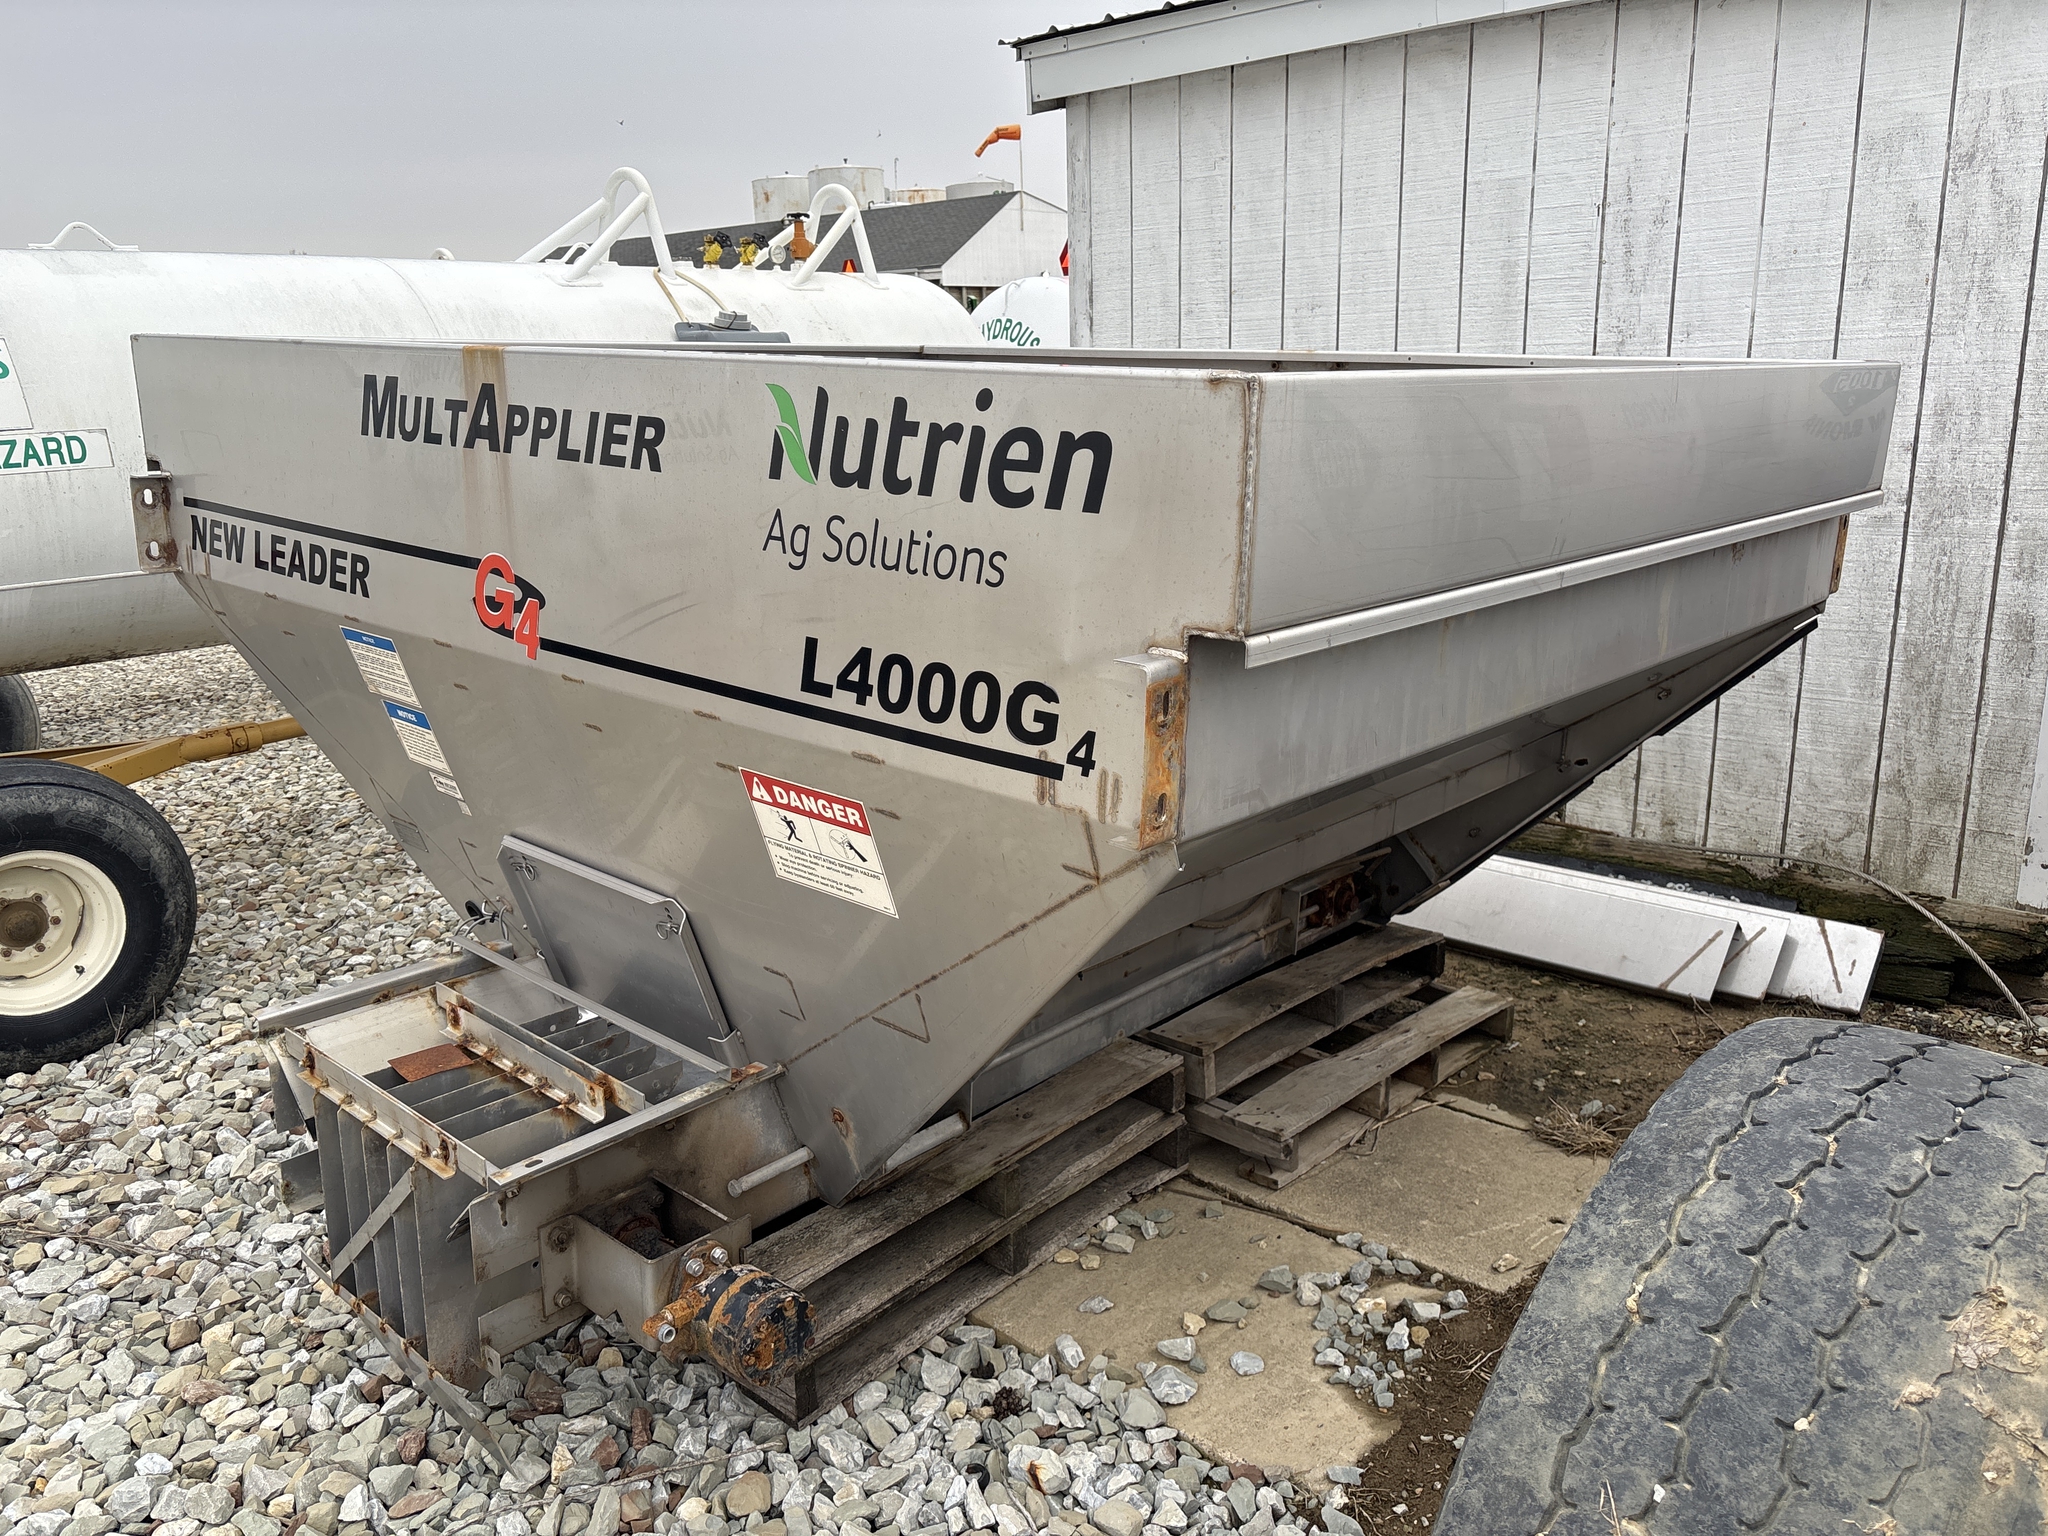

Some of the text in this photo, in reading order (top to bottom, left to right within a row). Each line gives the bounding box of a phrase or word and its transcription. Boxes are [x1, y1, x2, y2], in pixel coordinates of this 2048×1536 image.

[0, 436, 87, 469] ZARD
[767, 383, 1113, 515] Nutrien
[190, 514, 370, 599] NEW LEADER
[763, 509, 1008, 588] Ag Solutions
[396, 708, 418, 723] NOTICE
[772, 785, 864, 828] DANGER
